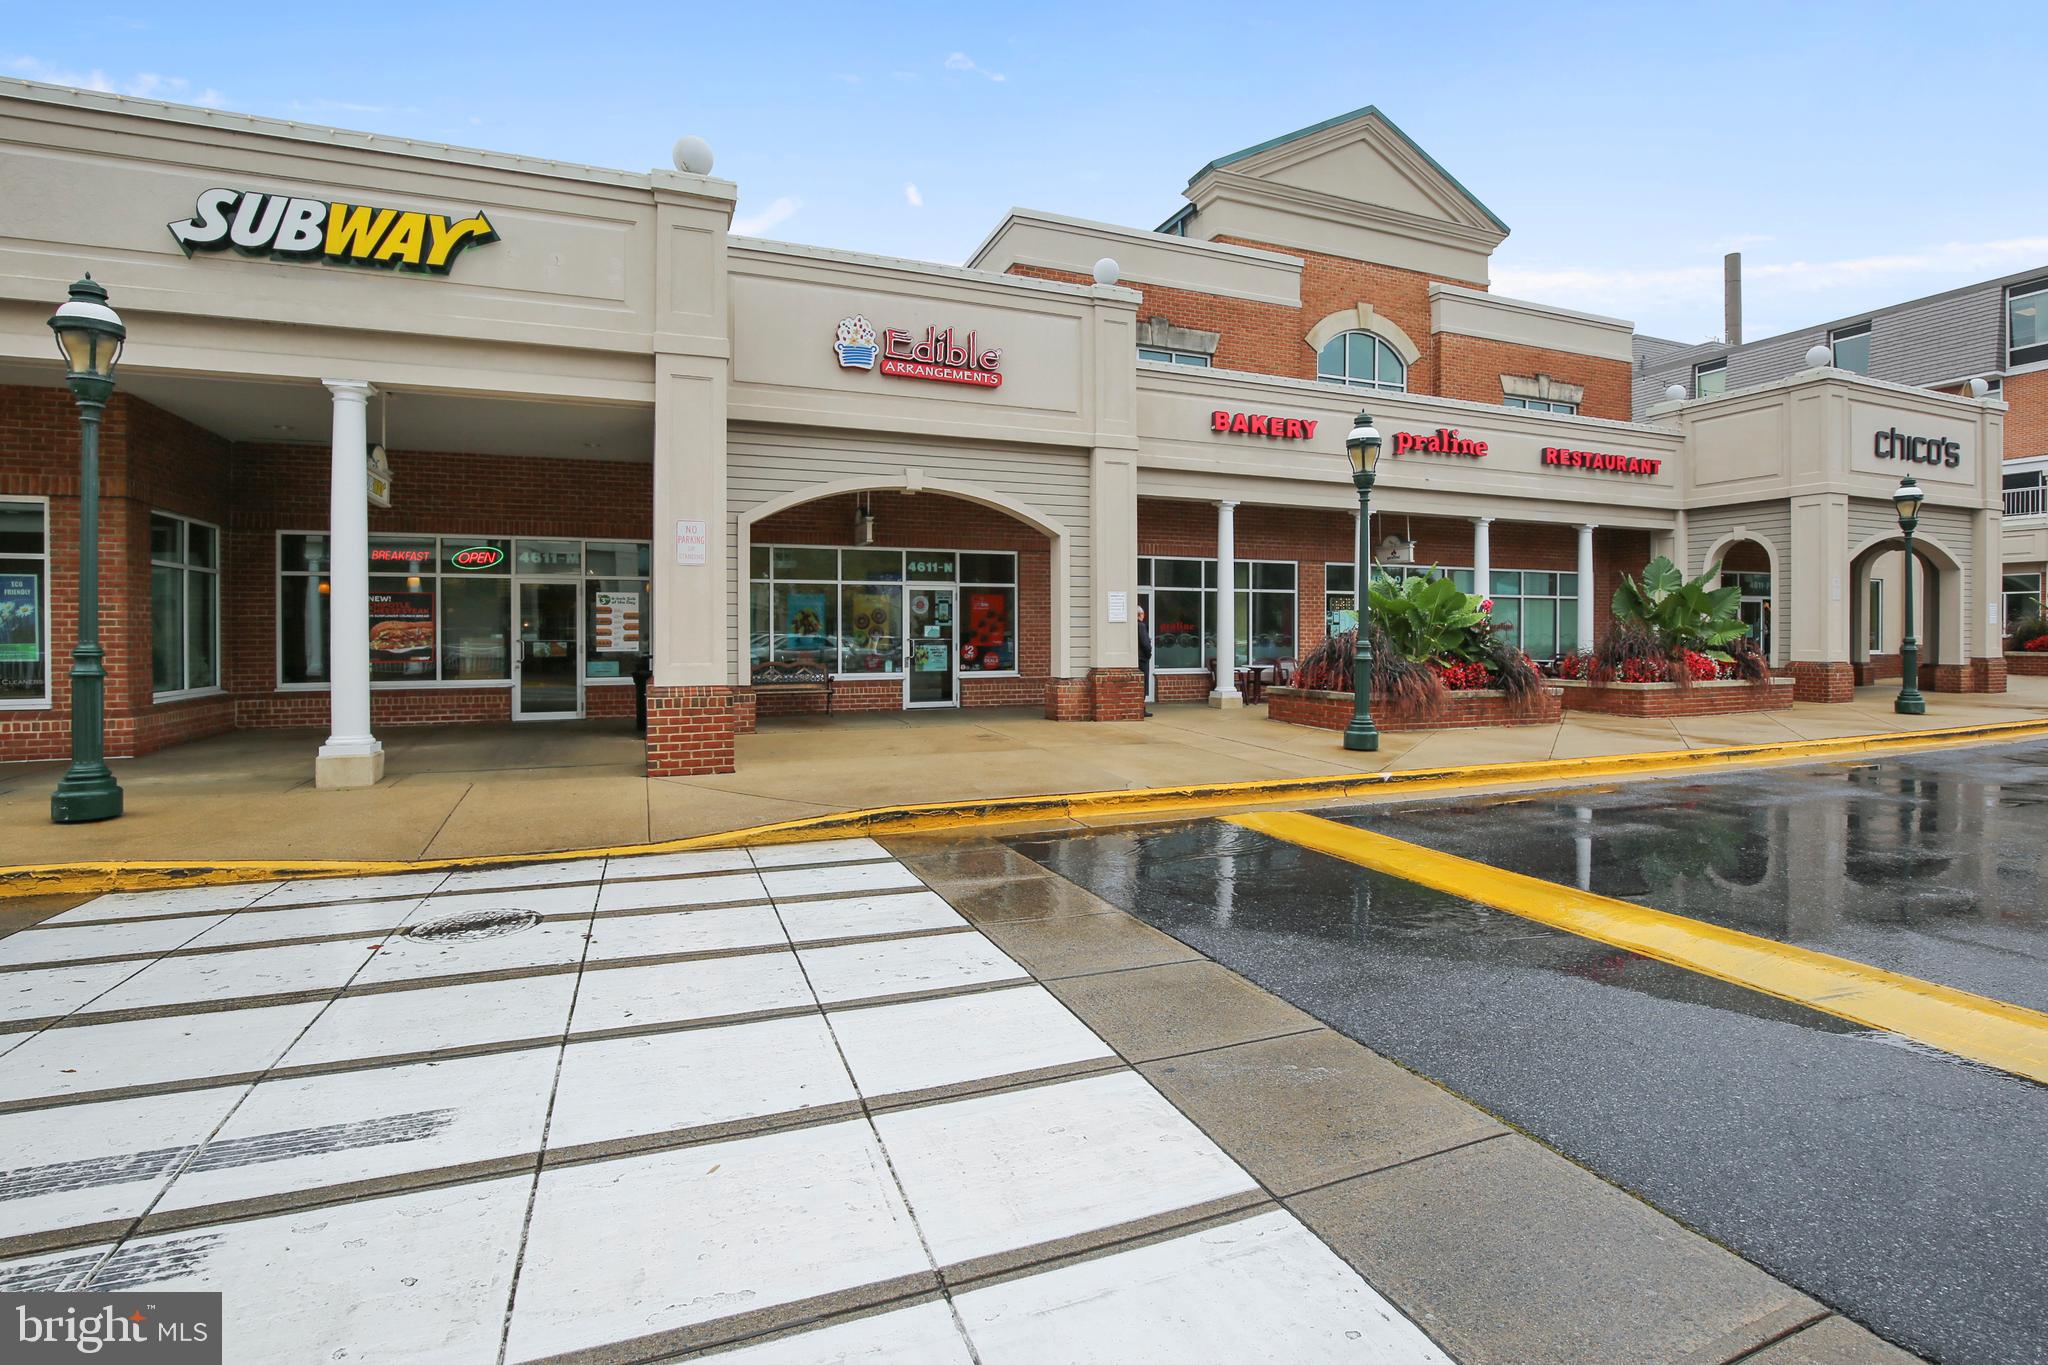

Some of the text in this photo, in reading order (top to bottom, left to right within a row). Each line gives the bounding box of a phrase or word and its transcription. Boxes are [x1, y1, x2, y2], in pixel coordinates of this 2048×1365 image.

[168, 187, 500, 276] SUBWAY
[884, 325, 1001, 371] Edible
[885, 362, 998, 384] ARRANGEMENTS
[1212, 411, 1318, 440] BAKERY
[1393, 429, 1489, 458] praline
[1542, 447, 1662, 475] RESTAURANT
[677, 536, 704, 544] PARKING
[686, 525, 697, 534] NO
[371, 550, 430, 560] BREAKFAST
[458, 552, 497, 563] OPEN
[908, 562, 953, 572] 4611-N
